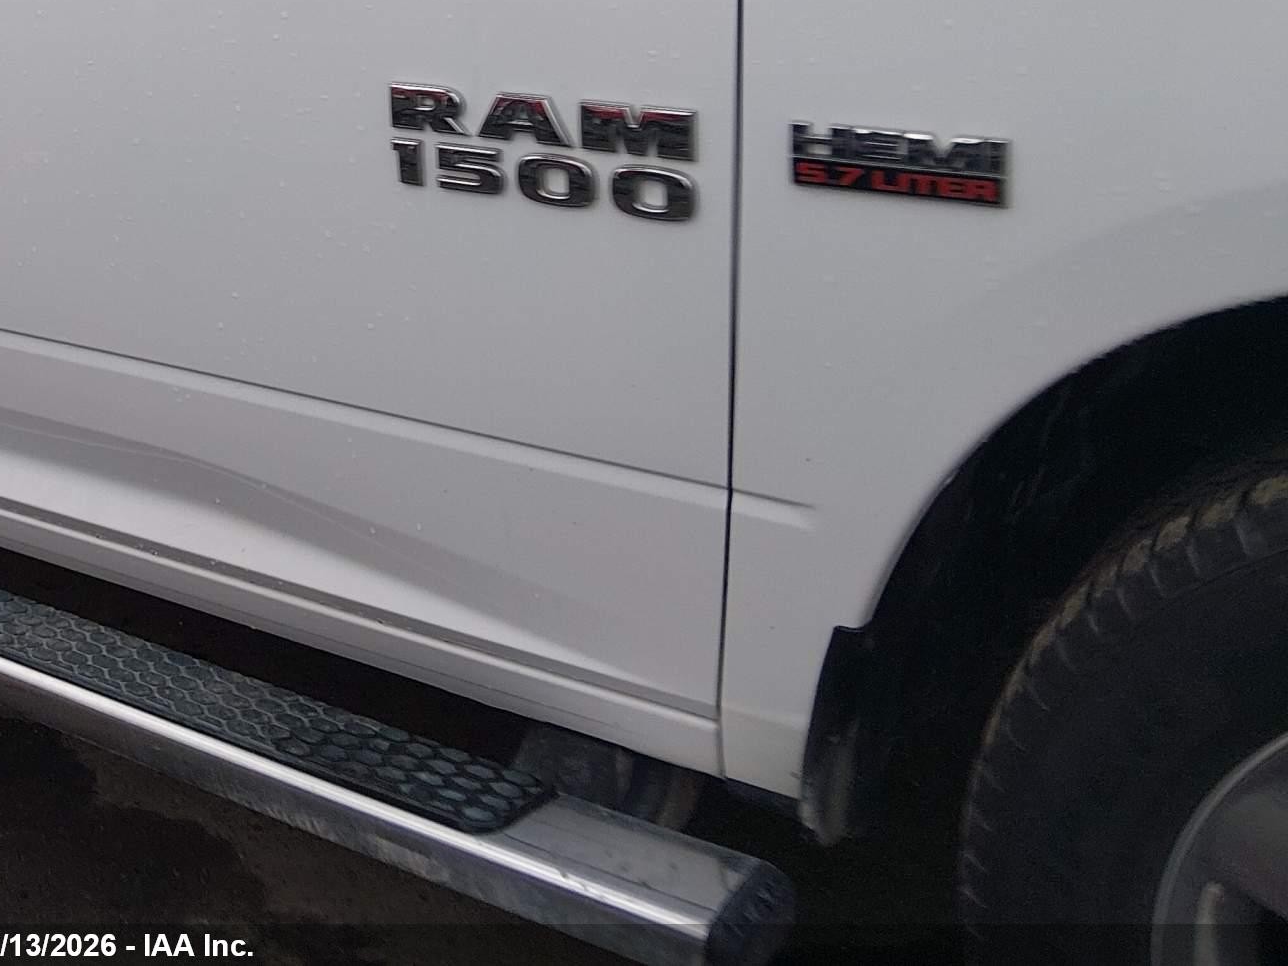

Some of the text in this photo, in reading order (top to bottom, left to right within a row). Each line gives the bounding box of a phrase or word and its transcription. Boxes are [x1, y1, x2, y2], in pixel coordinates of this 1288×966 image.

[390, 82, 700, 161] RAM
[789, 120, 1010, 177] HEMI
[390, 137, 698, 222] 1500
[870, 169, 1000, 203] LITER
